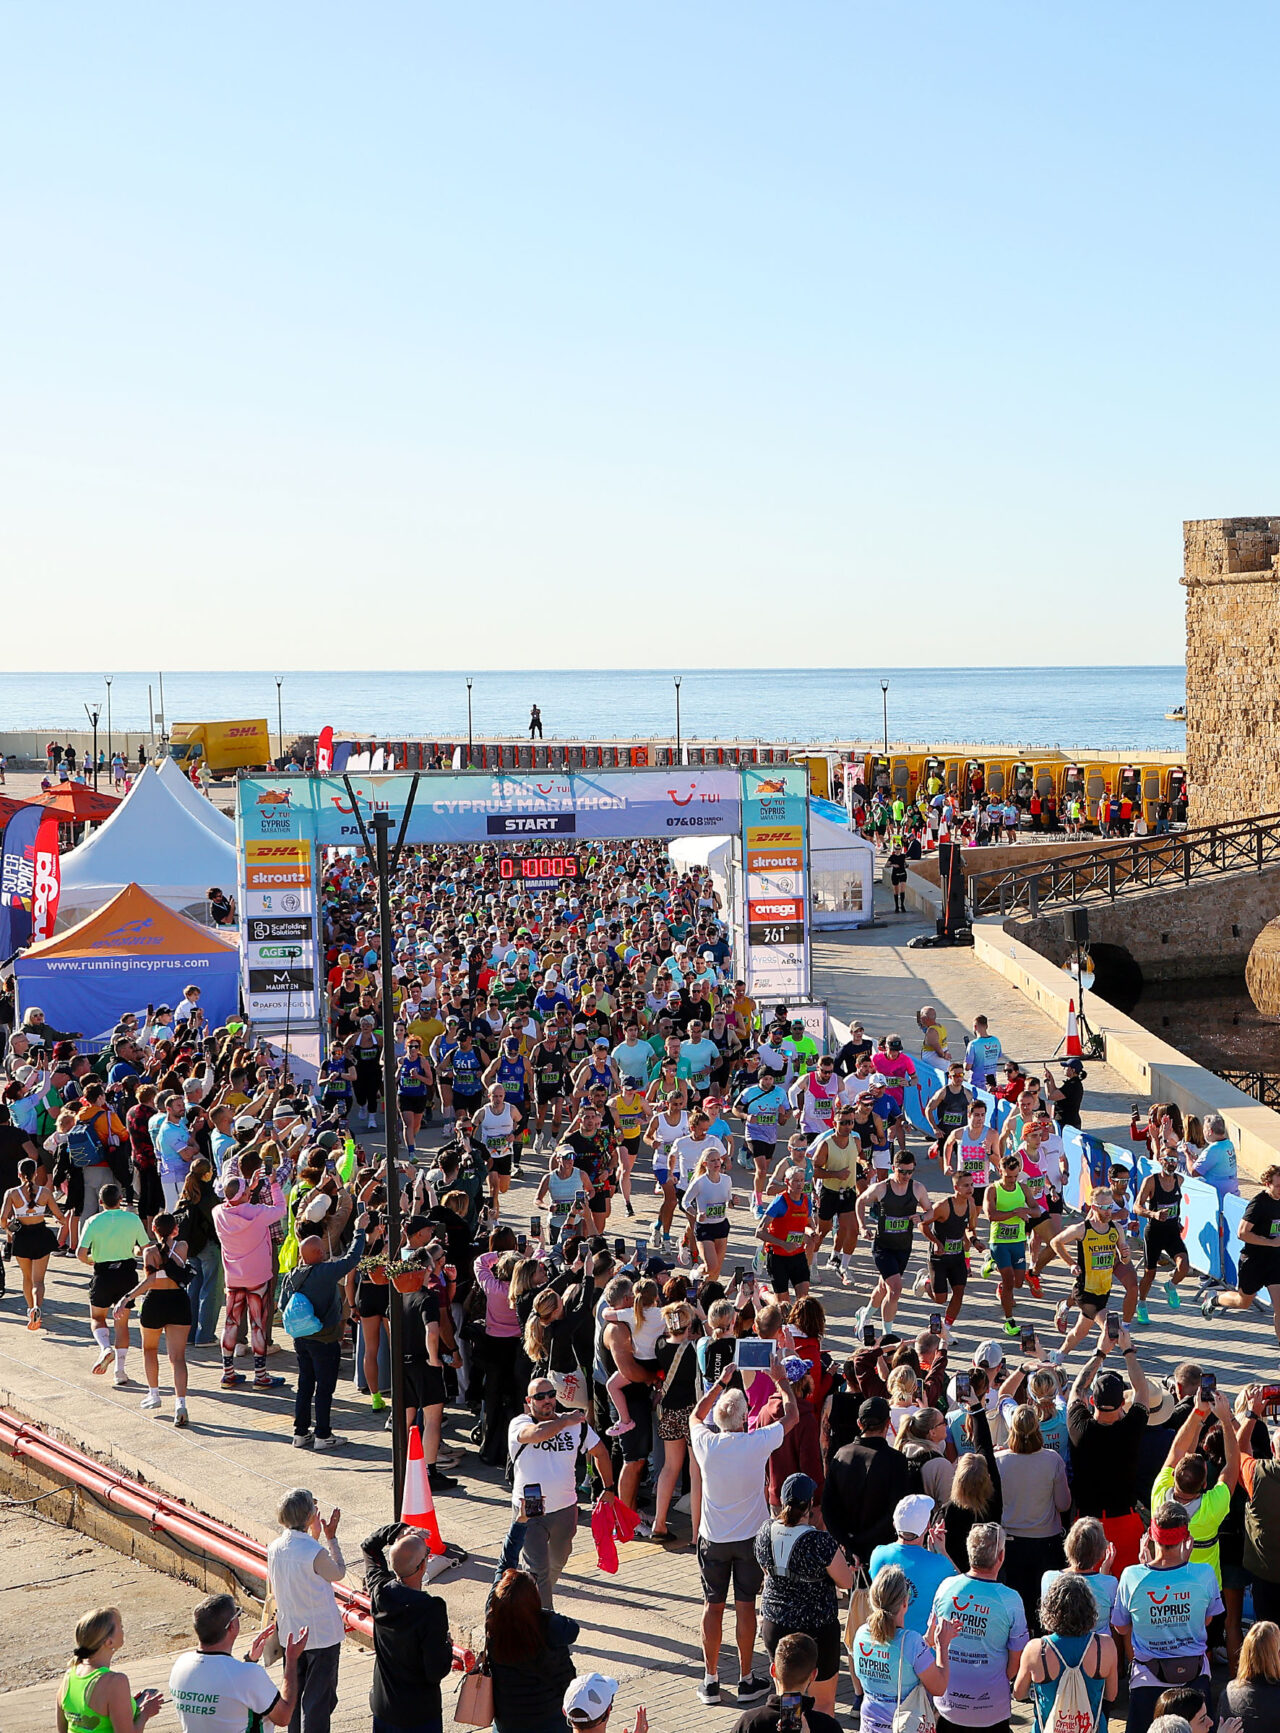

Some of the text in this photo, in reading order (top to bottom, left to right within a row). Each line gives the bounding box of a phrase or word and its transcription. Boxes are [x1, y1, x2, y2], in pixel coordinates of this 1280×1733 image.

[229, 727, 259, 737] DHL
[491, 782, 534, 797] 28th
[556, 785, 571, 793] TUI
[699, 793, 720, 804] TUI
[367, 800, 389, 811] TUI
[432, 795, 627, 815] CYPRUS MARATHON
[760, 806, 786, 815] CYPRUS
[261, 819, 291, 828] CYPRUS
[505, 818, 559, 831] START
[666, 816, 704, 827] 07&08
[341, 825, 376, 835] PAFO
[755, 832, 793, 842] DHL
[256, 846, 300, 857] DHL
[752, 856, 798, 868] skroutz
[2, 853, 20, 893] SUPER
[16, 855, 35, 896] SPORT
[252, 871, 306, 884] skroutz
[525, 879, 559, 888] MARATHON
[755, 904, 796, 917] omega
[270, 923, 307, 931] Scaffolding
[261, 947, 301, 957] AGETIS
[46, 958, 210, 972] www.runningincyprus.com
[265, 983, 299, 991] MAURTEN
[963, 1160, 983, 1170] 2306
[708, 1206, 726, 1216] 2304
[1096, 1256, 1112, 1265] 1012
[1046, 1433, 1060, 1441] TUI
[1173, 1591, 1190, 1601] TUI
[974, 1603, 991, 1615] TUI
[1149, 1602, 1191, 1618] CYPRUS
[950, 1611, 988, 1629] CYPRUS
[1150, 1613, 1191, 1625] MARATHON
[959, 1626, 987, 1637] RATHON
[877, 1650, 890, 1659] TUI
[858, 1656, 890, 1673] CYPRUS
[859, 1668, 892, 1681] MARATHON
[176, 1702, 217, 1715] ARRIERS
